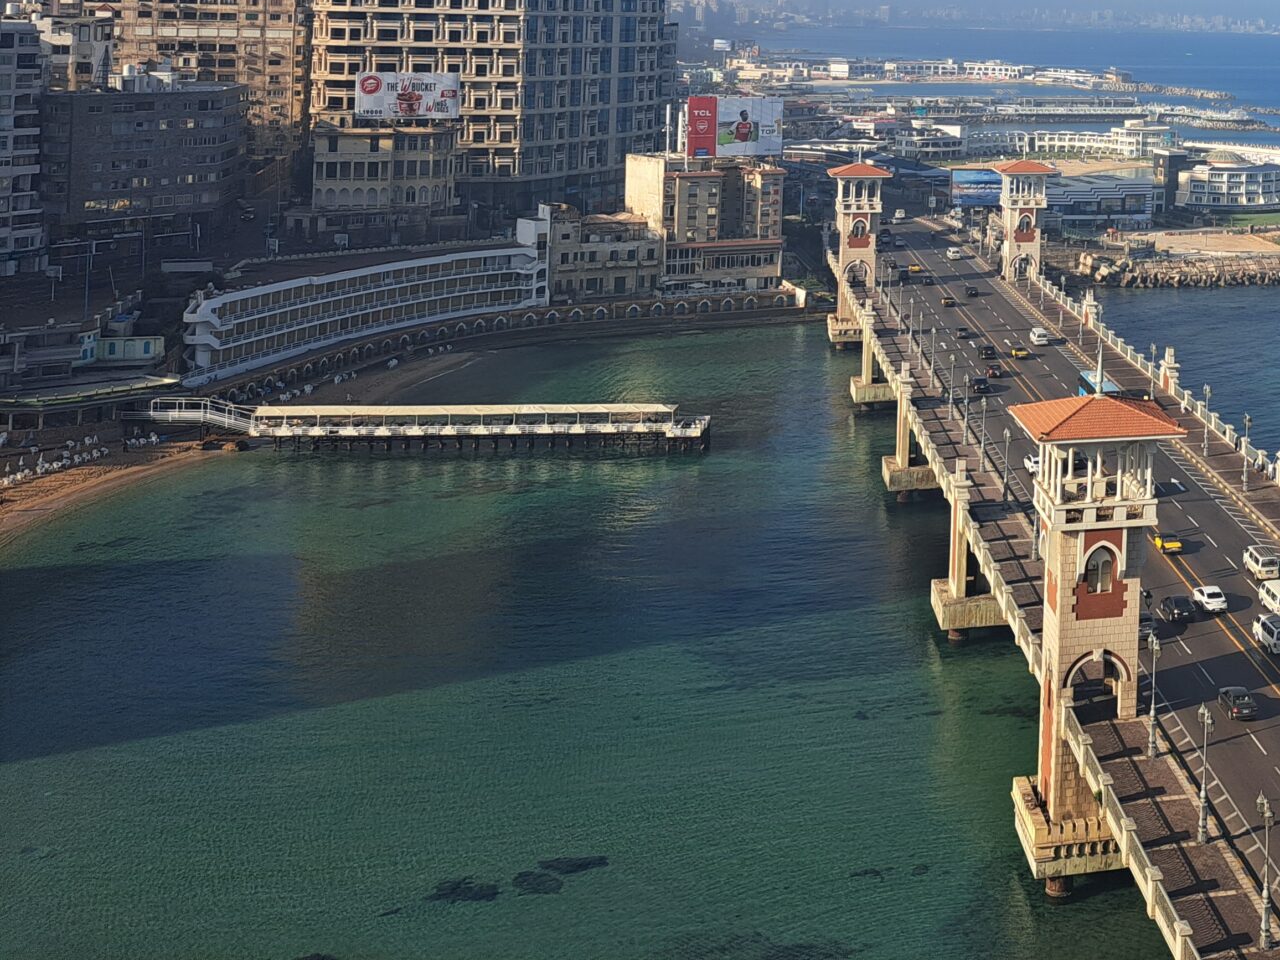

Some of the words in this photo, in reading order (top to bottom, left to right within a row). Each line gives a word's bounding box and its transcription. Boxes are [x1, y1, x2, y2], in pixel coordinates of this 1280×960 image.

[387, 82, 399, 92] THE
[411, 82, 437, 92] BUCKET
[772, 188, 780, 237] HOTEL
